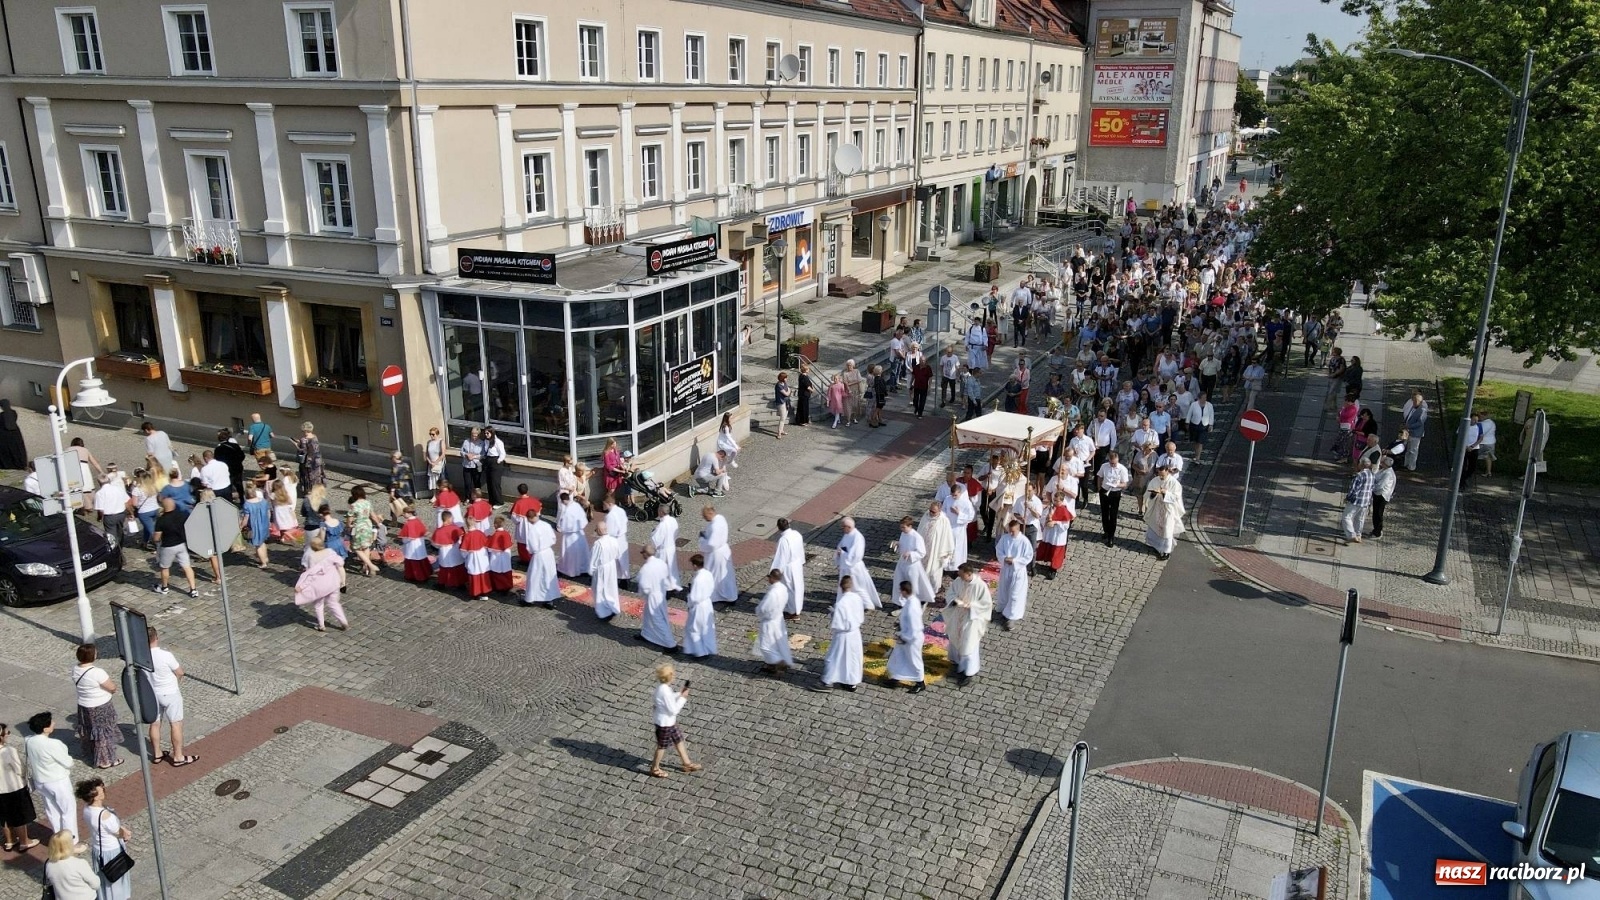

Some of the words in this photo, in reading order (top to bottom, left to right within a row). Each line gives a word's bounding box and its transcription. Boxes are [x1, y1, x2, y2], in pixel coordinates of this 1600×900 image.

[1098, 71, 1170, 79] ALEXANDER
[769, 211, 804, 230] ZDROWIT
[473, 255, 493, 264] INDIAN
[517, 259, 541, 267] KITCHEN
